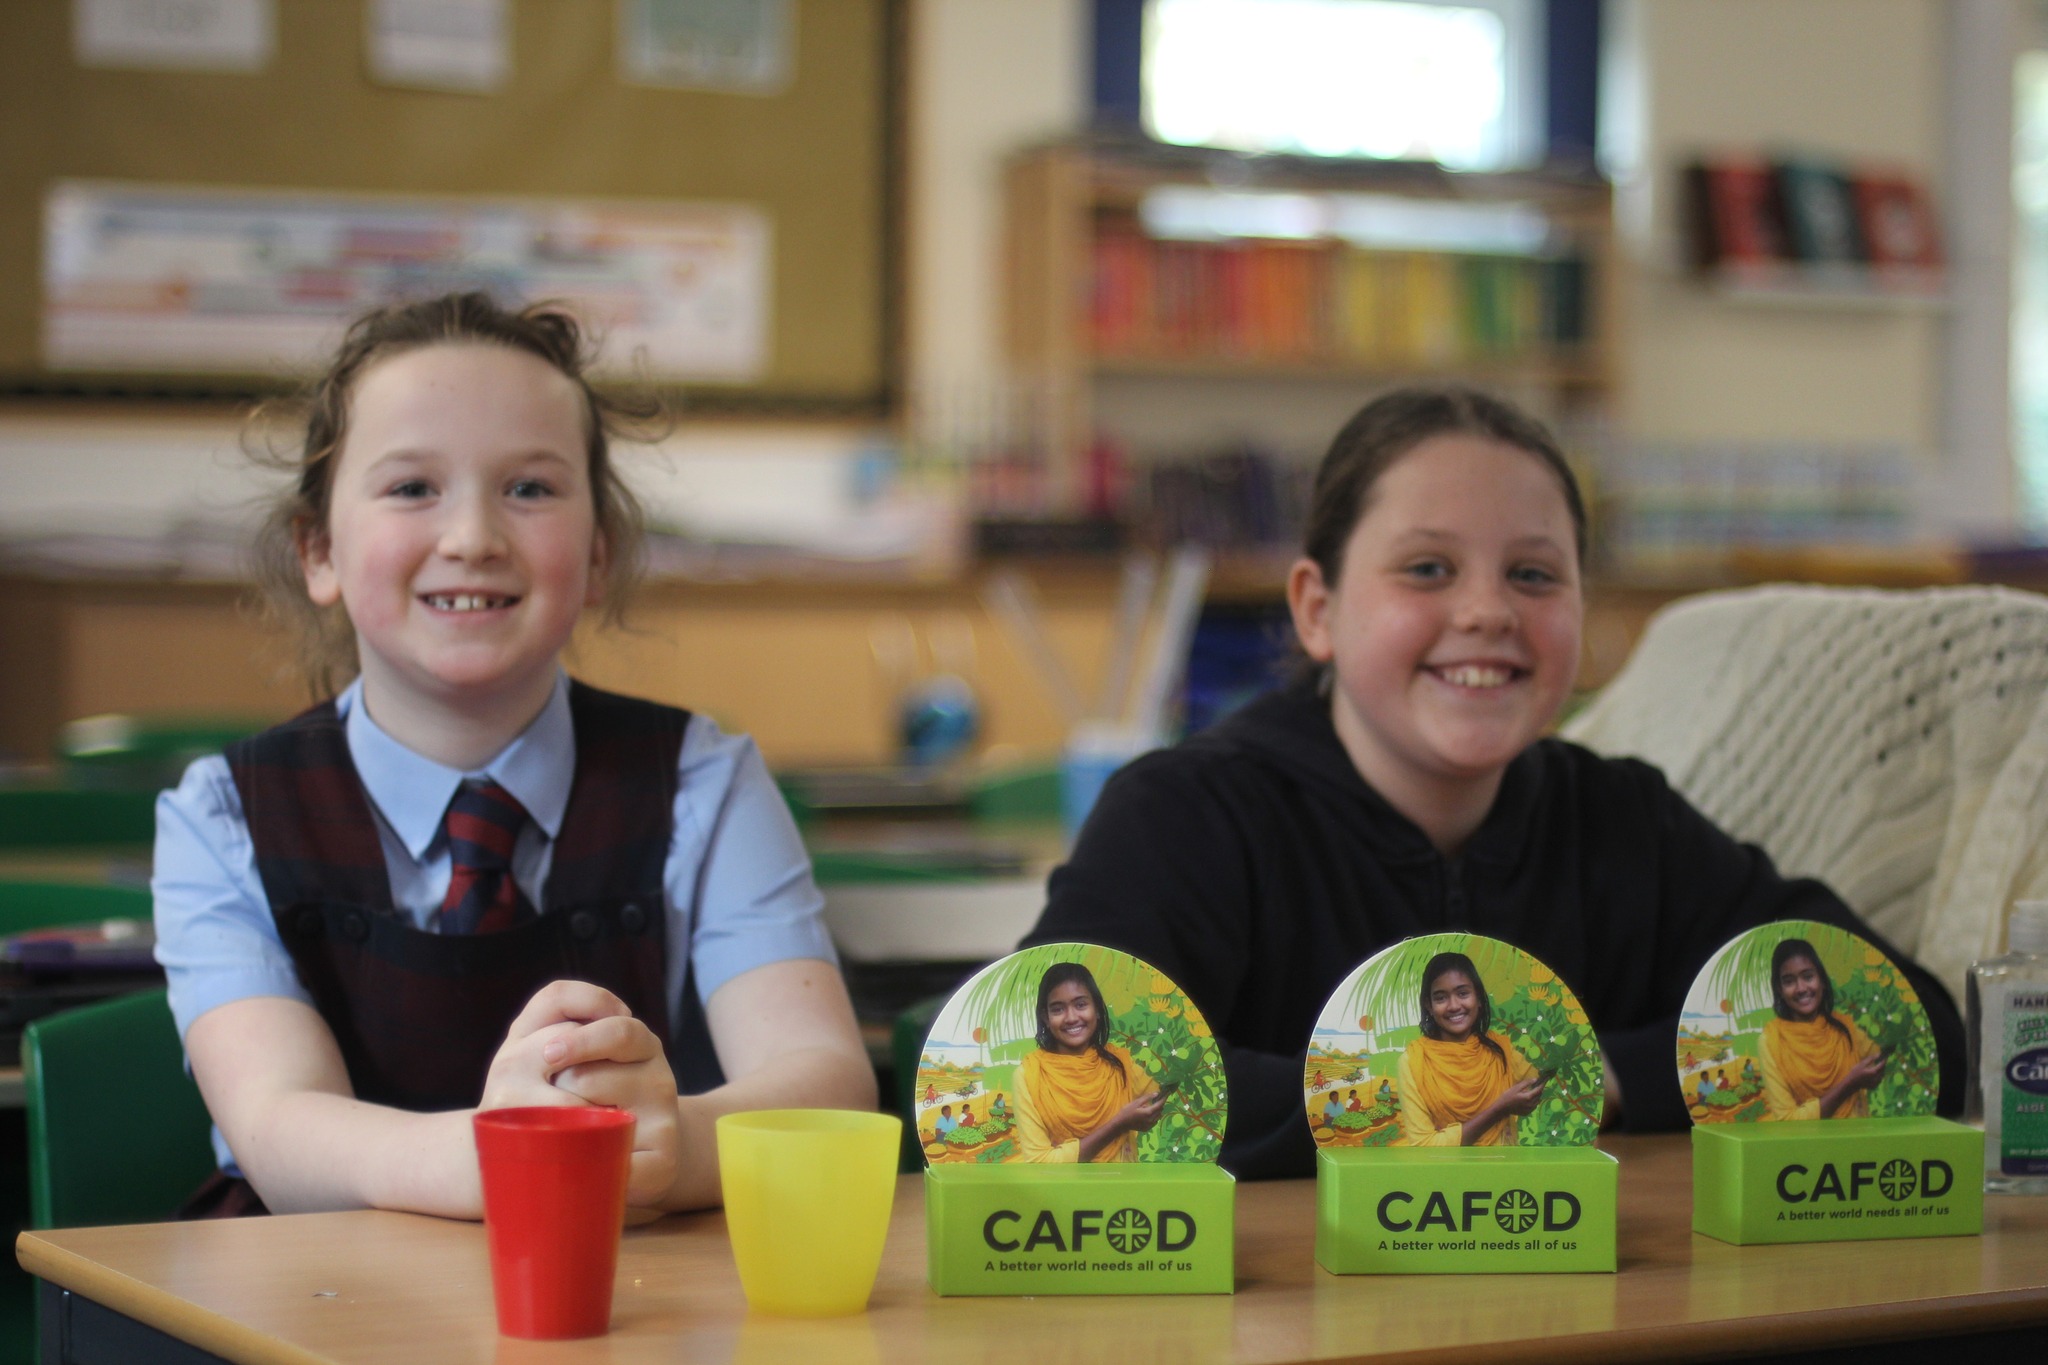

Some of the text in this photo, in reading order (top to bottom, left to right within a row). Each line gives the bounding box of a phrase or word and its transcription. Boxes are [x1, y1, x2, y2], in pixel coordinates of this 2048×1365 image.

[2013, 997, 2048, 1008] HAN
[1775, 1158, 1954, 1203] CAFOD
[1376, 1189, 1581, 1234] CAFOD
[1776, 1205, 1950, 1221] A better world needs all of us
[983, 1208, 1197, 1255] CAFOD
[1378, 1239, 1577, 1251] A better world needs all of us
[984, 1259, 1192, 1272] A better world needs all of us
